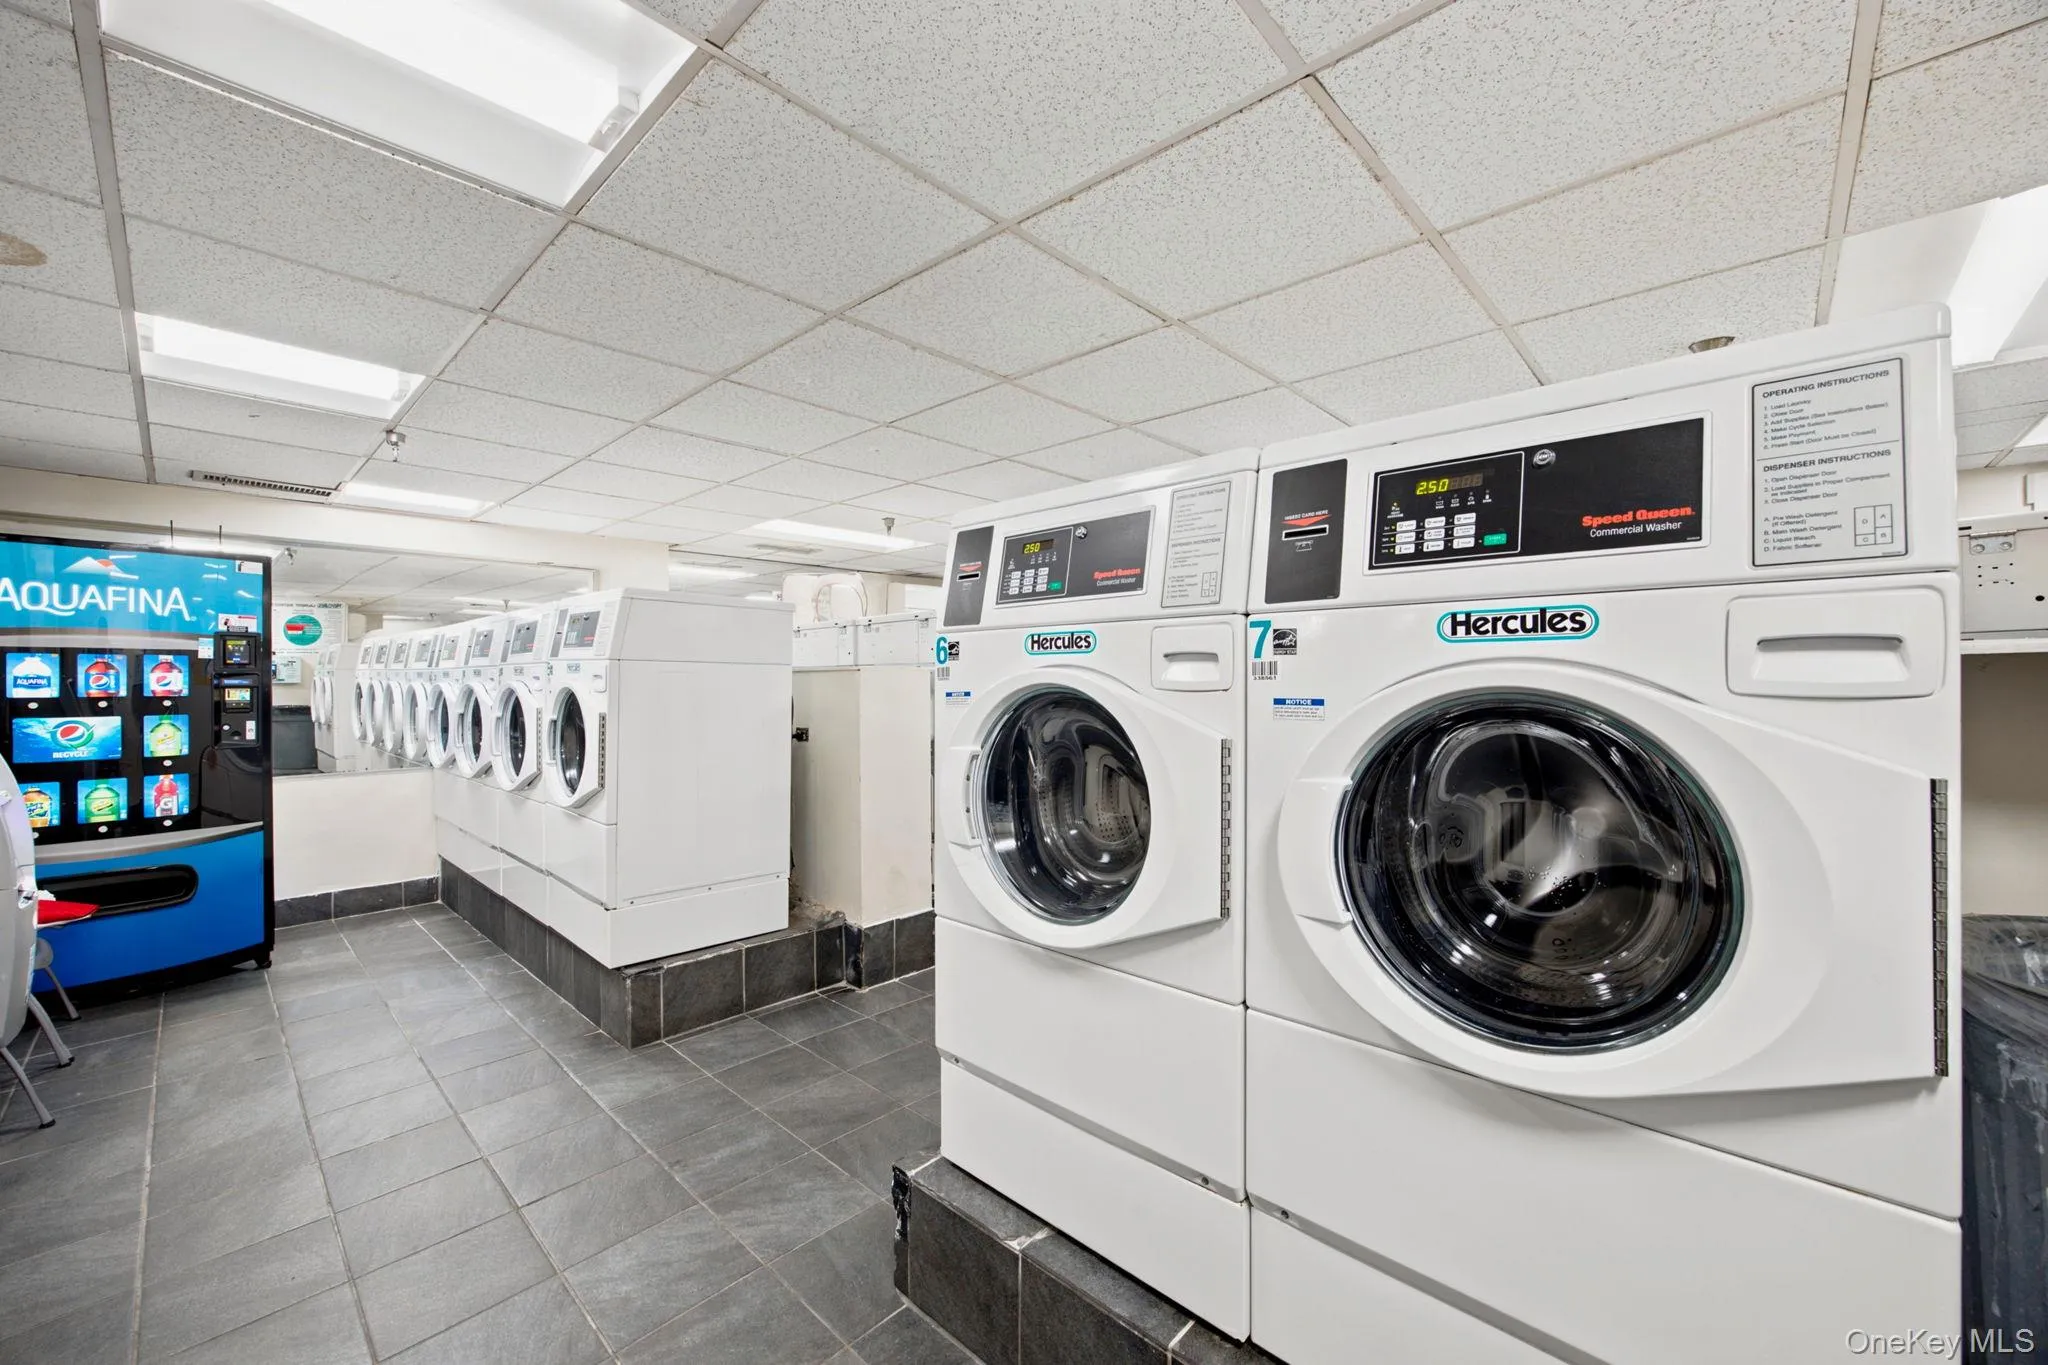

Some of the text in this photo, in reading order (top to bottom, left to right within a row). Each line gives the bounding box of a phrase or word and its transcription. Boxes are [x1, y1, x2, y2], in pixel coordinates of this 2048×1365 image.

[1762, 370, 1889, 398] OPERATING INSTRUCTIONS
[1763, 450, 1891, 472] DISPENSER INSTRUCTIONS
[1582, 511, 1633, 527] Speed
[1590, 522, 1682, 537] Commercial Washer
[0, 577, 190, 622] AQUAFINA
[1450, 608, 1587, 637] Hercules
[936, 637, 947, 664] 6
[1031, 632, 1091, 650] Hercules
[1249, 620, 1271, 658] 7
